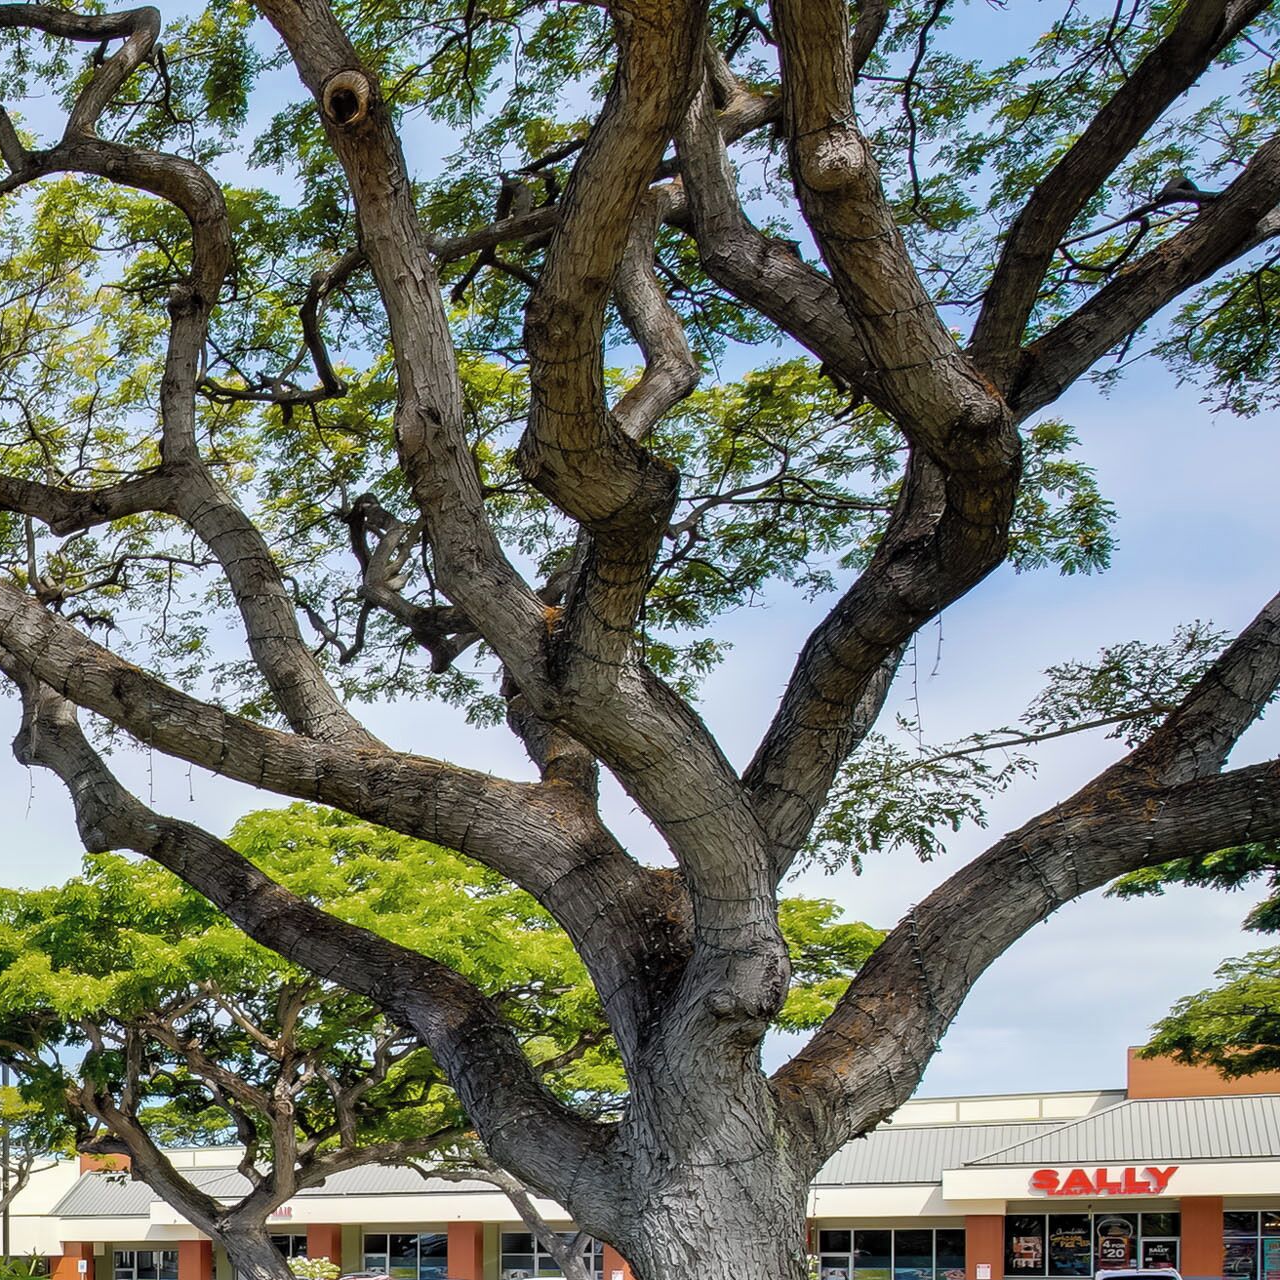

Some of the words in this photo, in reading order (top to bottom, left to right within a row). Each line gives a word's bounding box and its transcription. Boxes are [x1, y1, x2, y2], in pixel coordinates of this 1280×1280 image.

[1031, 1166, 1180, 1190] SALLY
[1102, 1240, 1110, 1248] 4
[1102, 1249, 1125, 1258] $20
